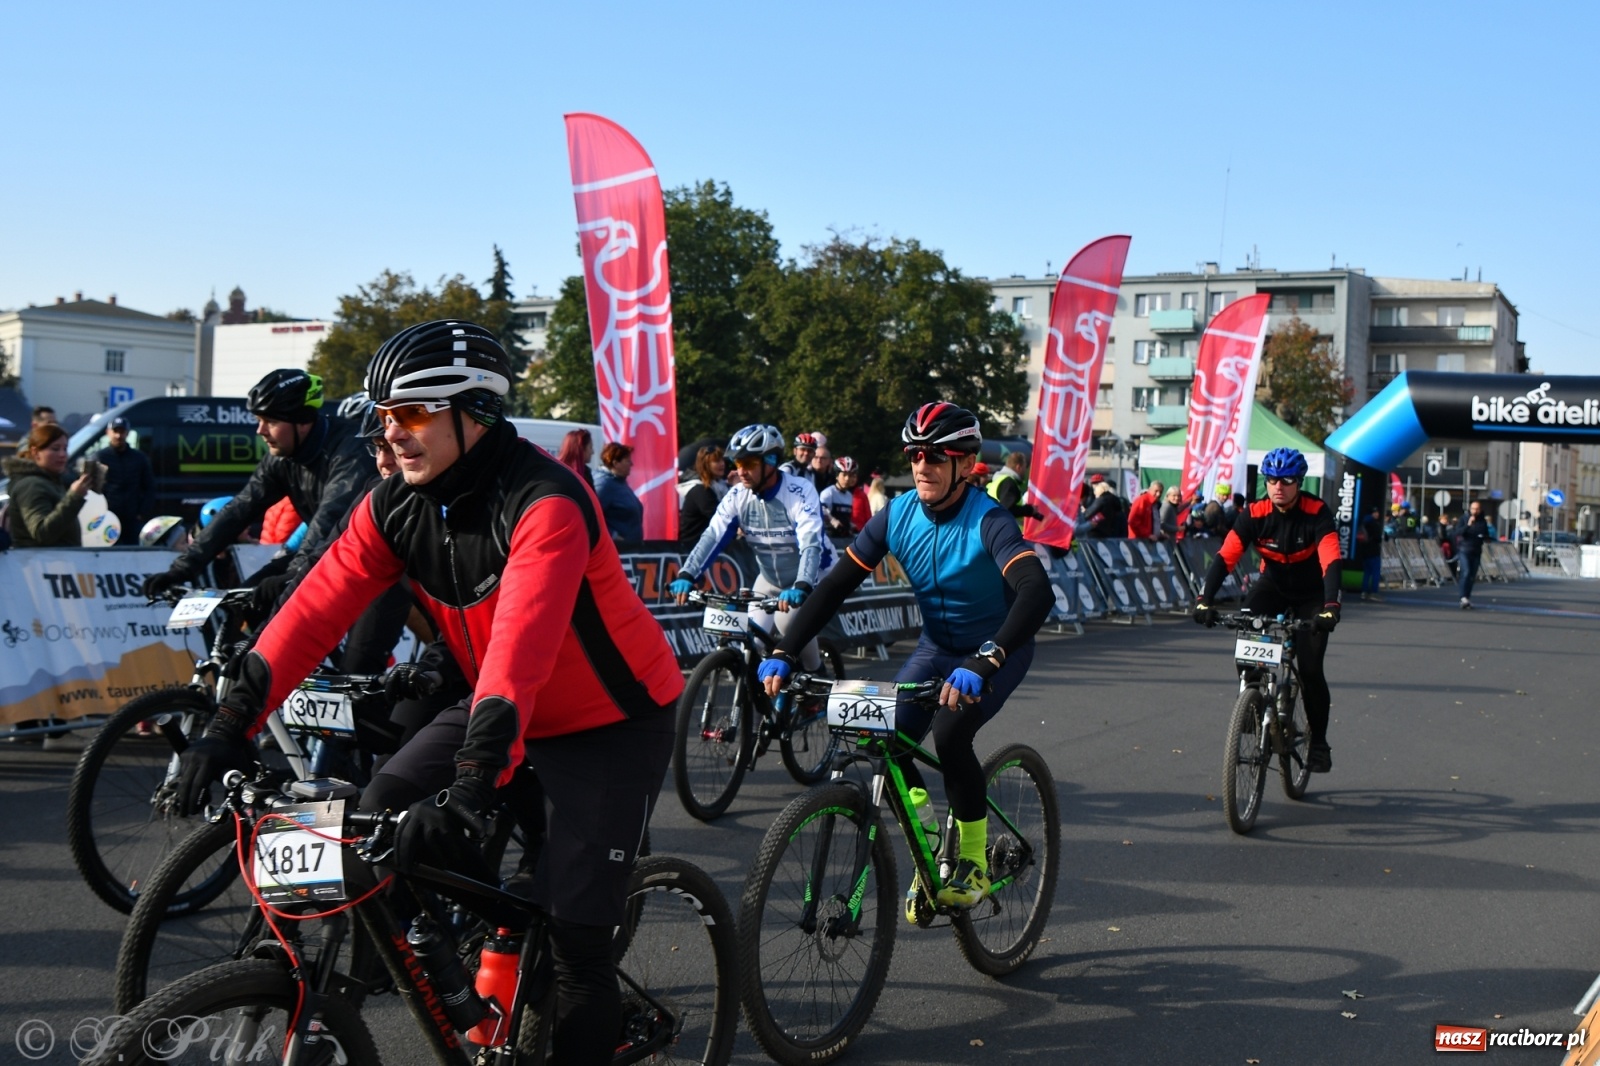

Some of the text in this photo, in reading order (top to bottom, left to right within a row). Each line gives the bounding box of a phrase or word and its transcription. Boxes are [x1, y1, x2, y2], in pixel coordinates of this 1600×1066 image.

[217, 405, 259, 424] bike
[1471, 395, 1600, 425] bike ateli
[1427, 460, 1441, 476] 0
[1337, 471, 1356, 522] atelier
[709, 613, 740, 628] 2996
[1243, 645, 1274, 659] 2724
[295, 698, 340, 720] 3077
[838, 702, 883, 722] 3144
[267, 842, 325, 876] 1817
[811, 1036, 848, 1059] MAXXIS
